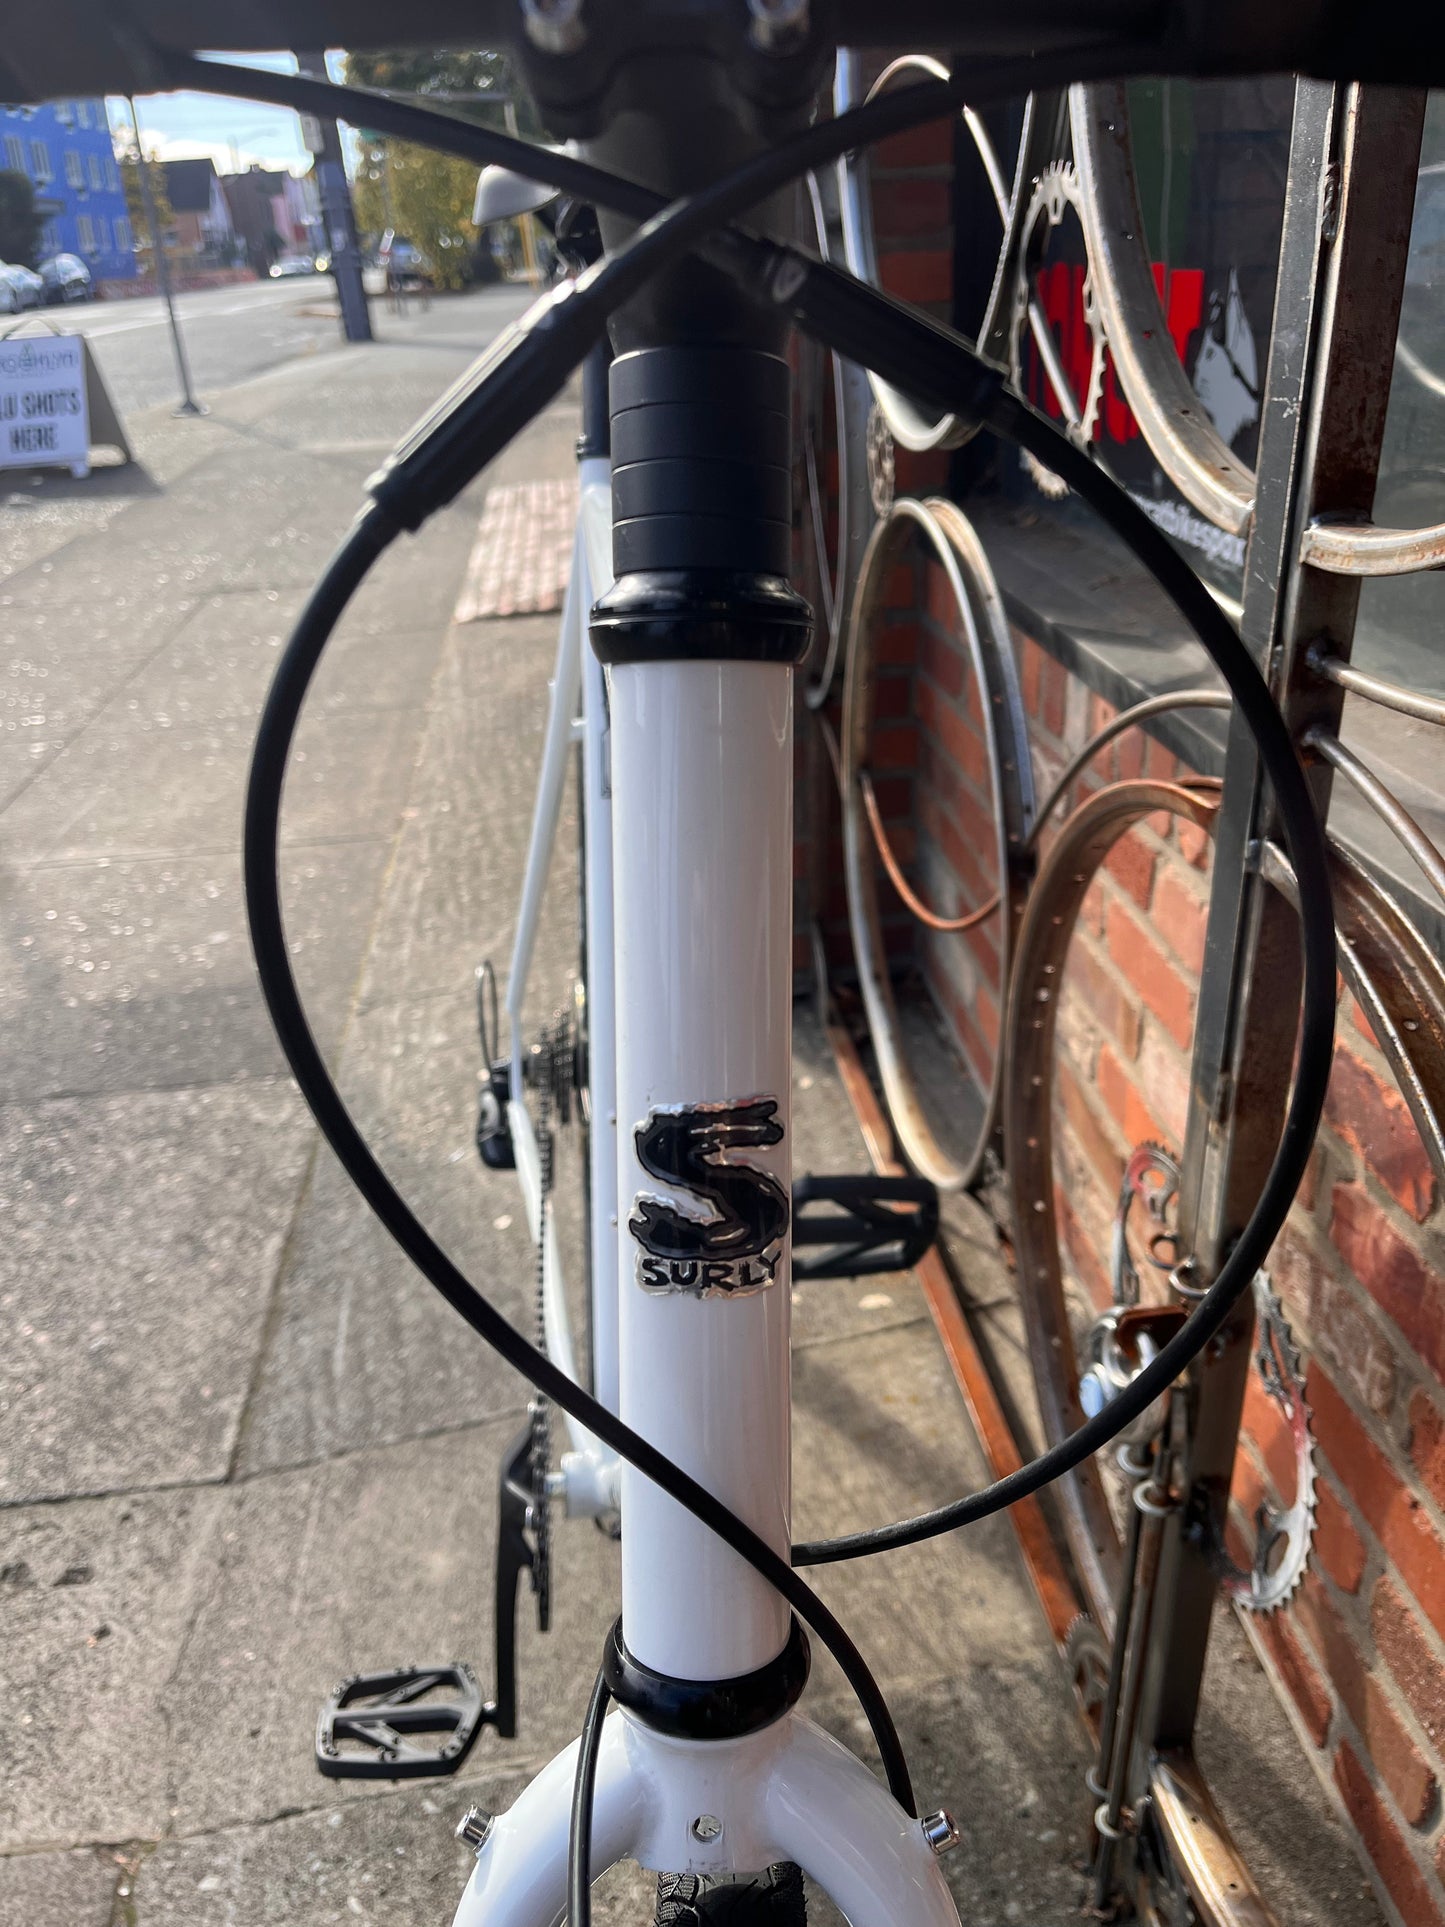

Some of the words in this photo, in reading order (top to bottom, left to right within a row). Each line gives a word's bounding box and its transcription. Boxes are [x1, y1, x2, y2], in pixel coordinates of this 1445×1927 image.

[22, 389, 80, 418] SHOTS
[10, 424, 58, 453] HERE
[642, 1249, 782, 1291] SURLY
